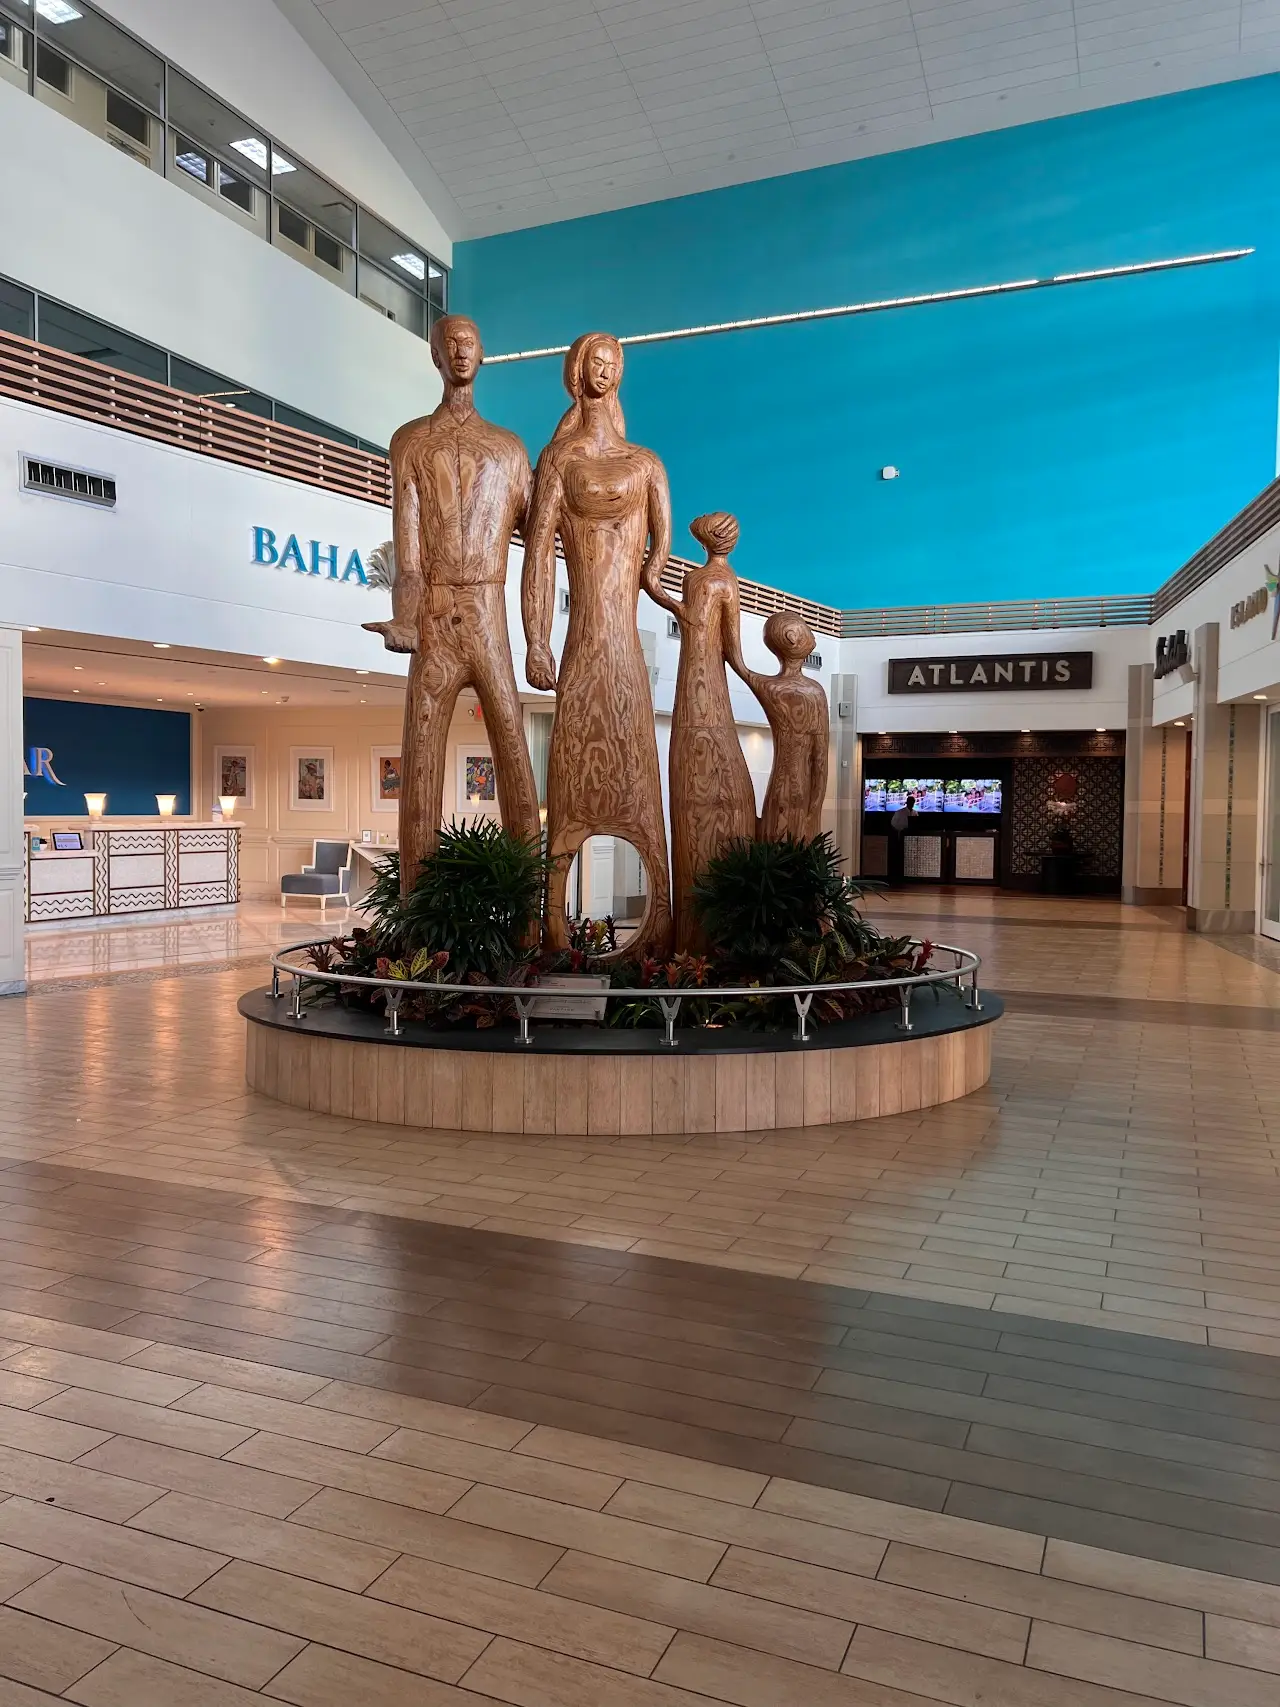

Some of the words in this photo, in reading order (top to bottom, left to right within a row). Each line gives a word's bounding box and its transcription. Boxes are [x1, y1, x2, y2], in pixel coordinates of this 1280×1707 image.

[251, 526, 370, 586] BAHA
[1230, 587, 1268, 630] ISLAND
[907, 659, 1071, 686] ATLANTIS
